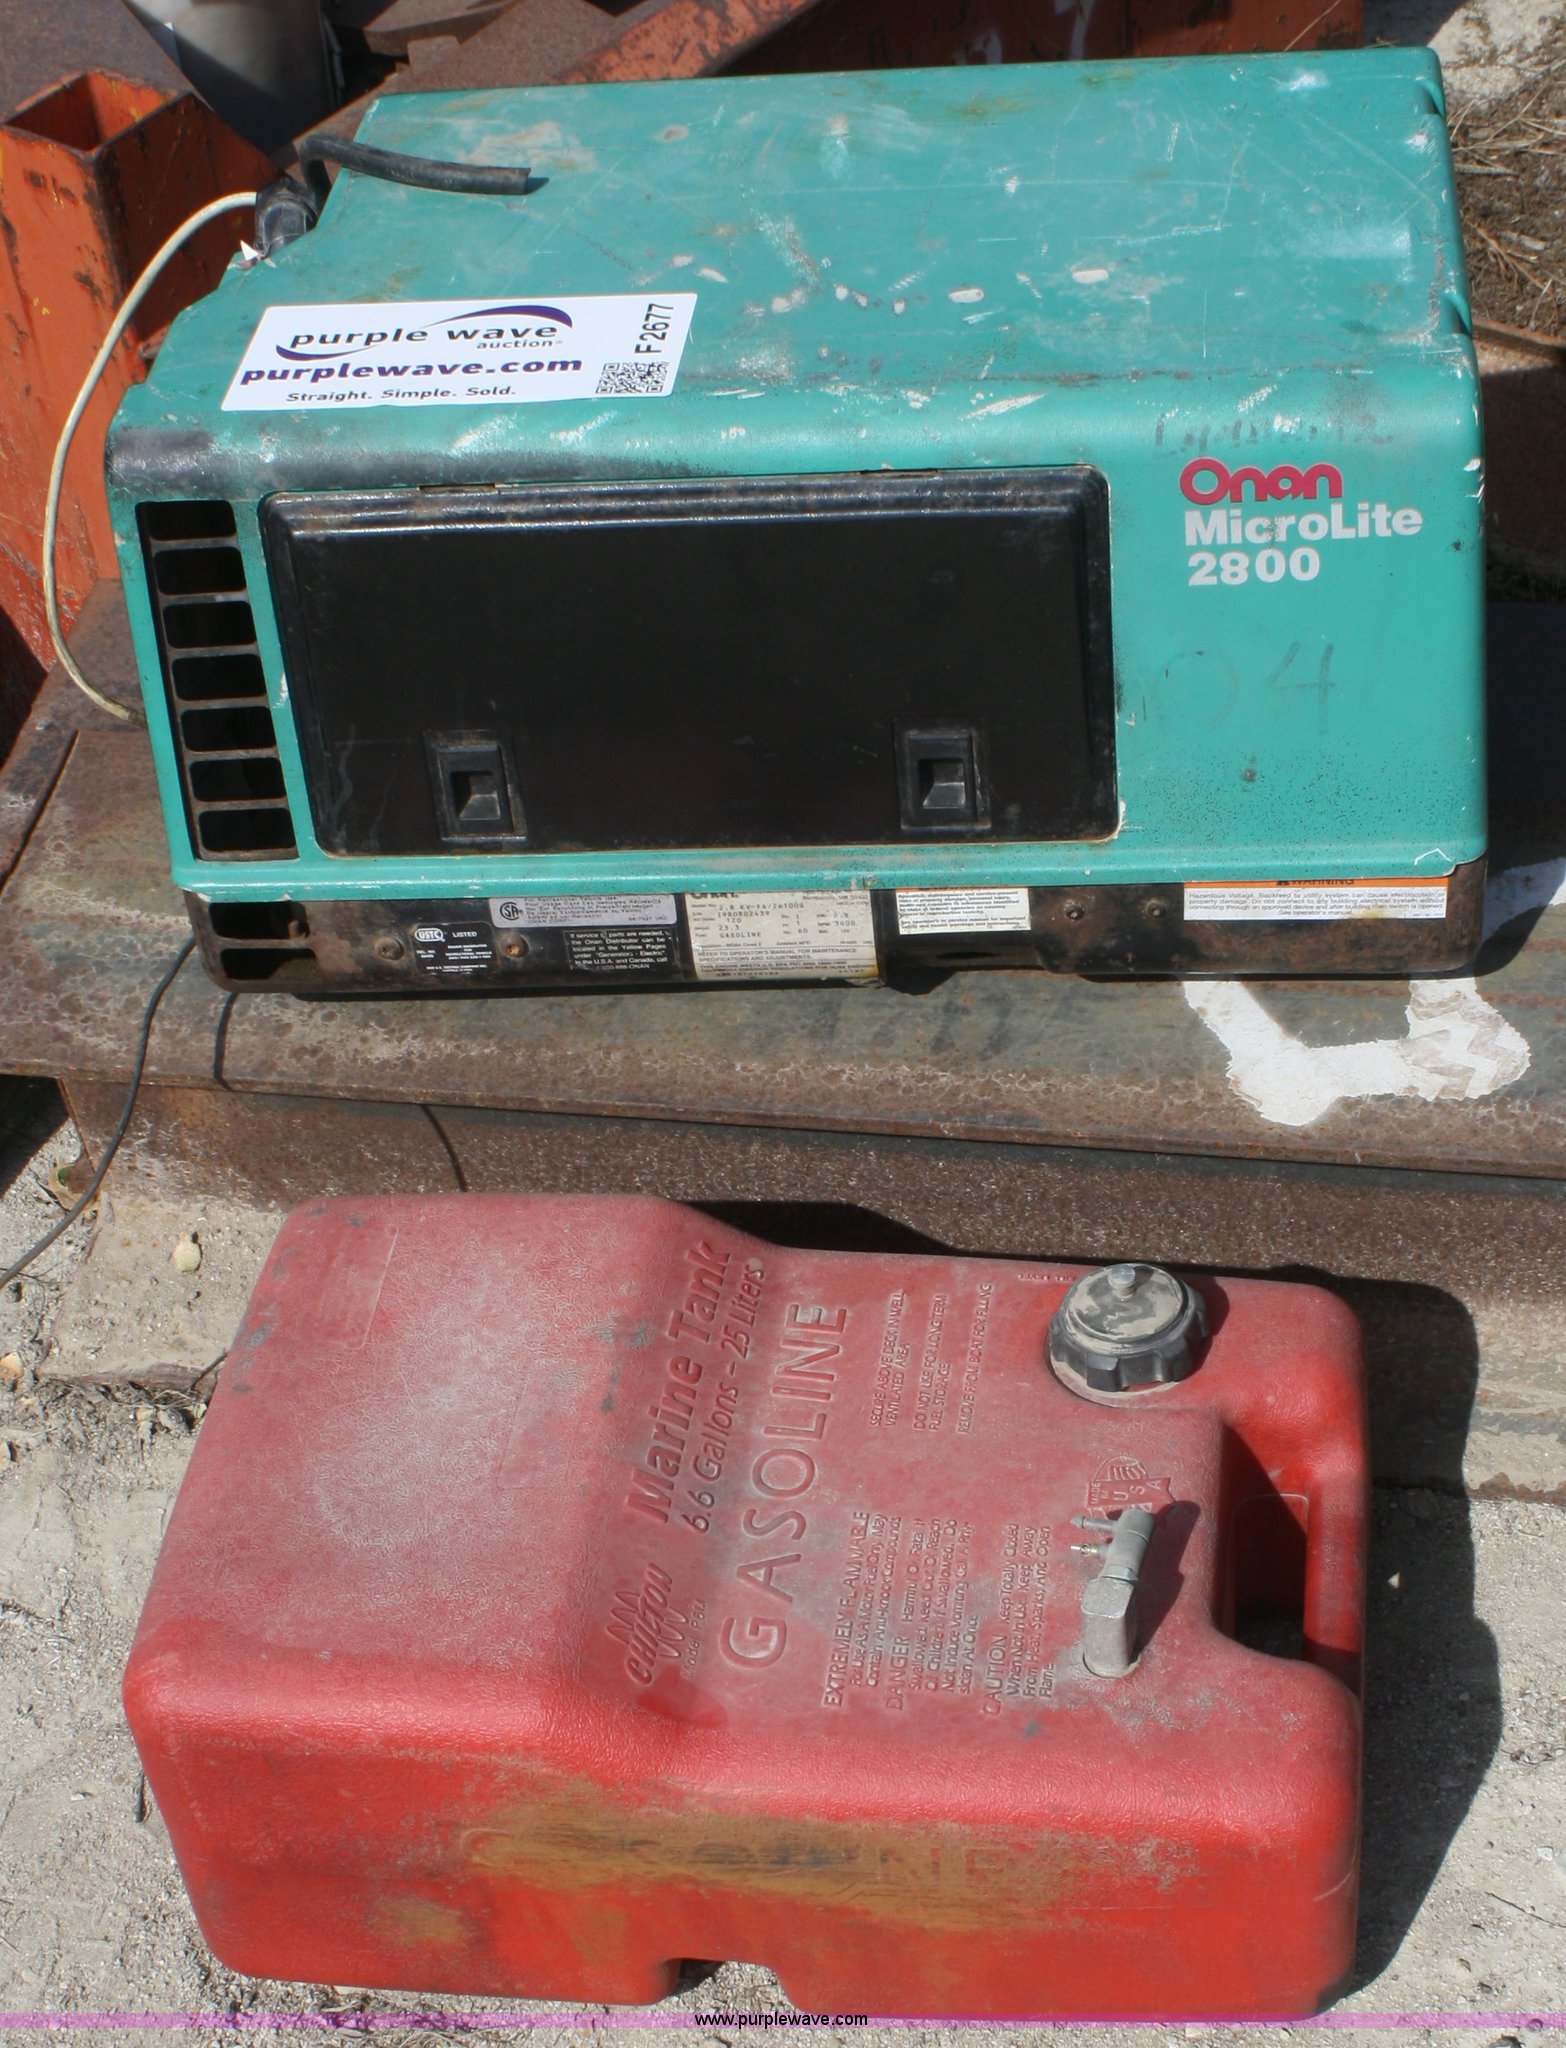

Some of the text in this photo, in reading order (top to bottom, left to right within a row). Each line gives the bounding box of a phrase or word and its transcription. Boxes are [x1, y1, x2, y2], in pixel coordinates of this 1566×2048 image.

[289, 324, 558, 348] purple wave
[240, 358, 584, 387] purplewave.com
[286, 386, 517, 402] Straight. Simple. Sold.
[1179, 456, 1343, 506] Onan
[1184, 501, 1424, 547] MicroLite
[1187, 547, 1321, 587] 2800
[729, 1266, 764, 1325] Liters
[720, 1326, 751, 1359] 25
[625, 1240, 729, 1524] Marine Tank
[878, 1357, 891, 1389] ABOVE
[918, 1391, 930, 1411] NOT
[691, 1383, 738, 1481] Gallons
[914, 1414, 926, 1429] DO
[718, 1303, 848, 1671] GASOLINE
[681, 1491, 715, 1533] 6.6
[1003, 1524, 1019, 1557] Closed
[1021, 1526, 1035, 1557] Away
[852, 1649, 865, 1667] Use
[872, 1515, 888, 1537] May
[1000, 1560, 1017, 1595] Totally
[1017, 1564, 1032, 1591] Keep
[825, 1511, 869, 1706] EXTREMELY FLAMMABLE
[1024, 1667, 1038, 1697] From
[1036, 1526, 1051, 1556] Open
[866, 1644, 883, 1686] Contain
[945, 1631, 961, 1667] Induce
[885, 1636, 912, 1710] DANGER
[983, 1634, 1007, 1715] CAUTION
[1007, 1661, 1022, 1695] When
